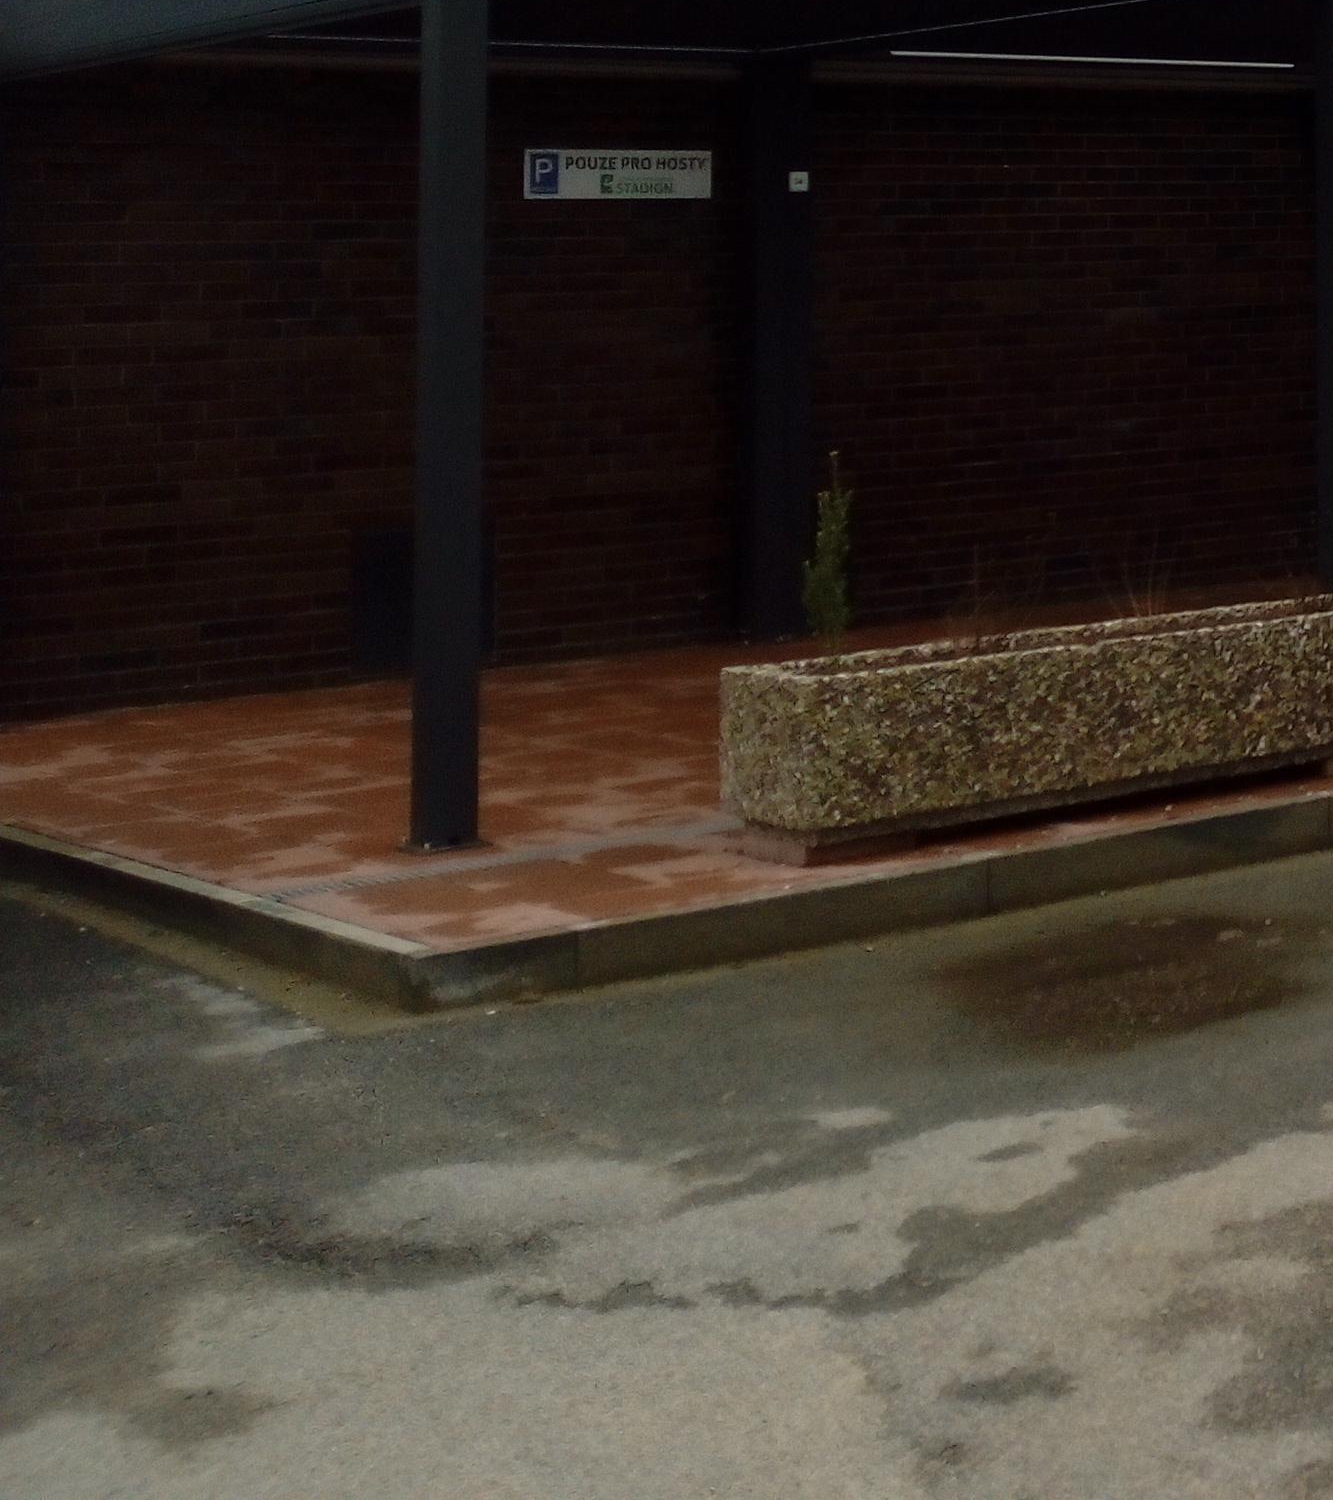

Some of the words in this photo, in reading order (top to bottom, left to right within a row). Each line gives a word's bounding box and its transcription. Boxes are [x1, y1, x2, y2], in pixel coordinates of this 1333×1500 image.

[535, 157, 553, 183] P
[565, 156, 616, 170] POUZE
[621, 156, 652, 170] PRO
[655, 156, 708, 170] HOSTY
[616, 182, 673, 194] STADION
